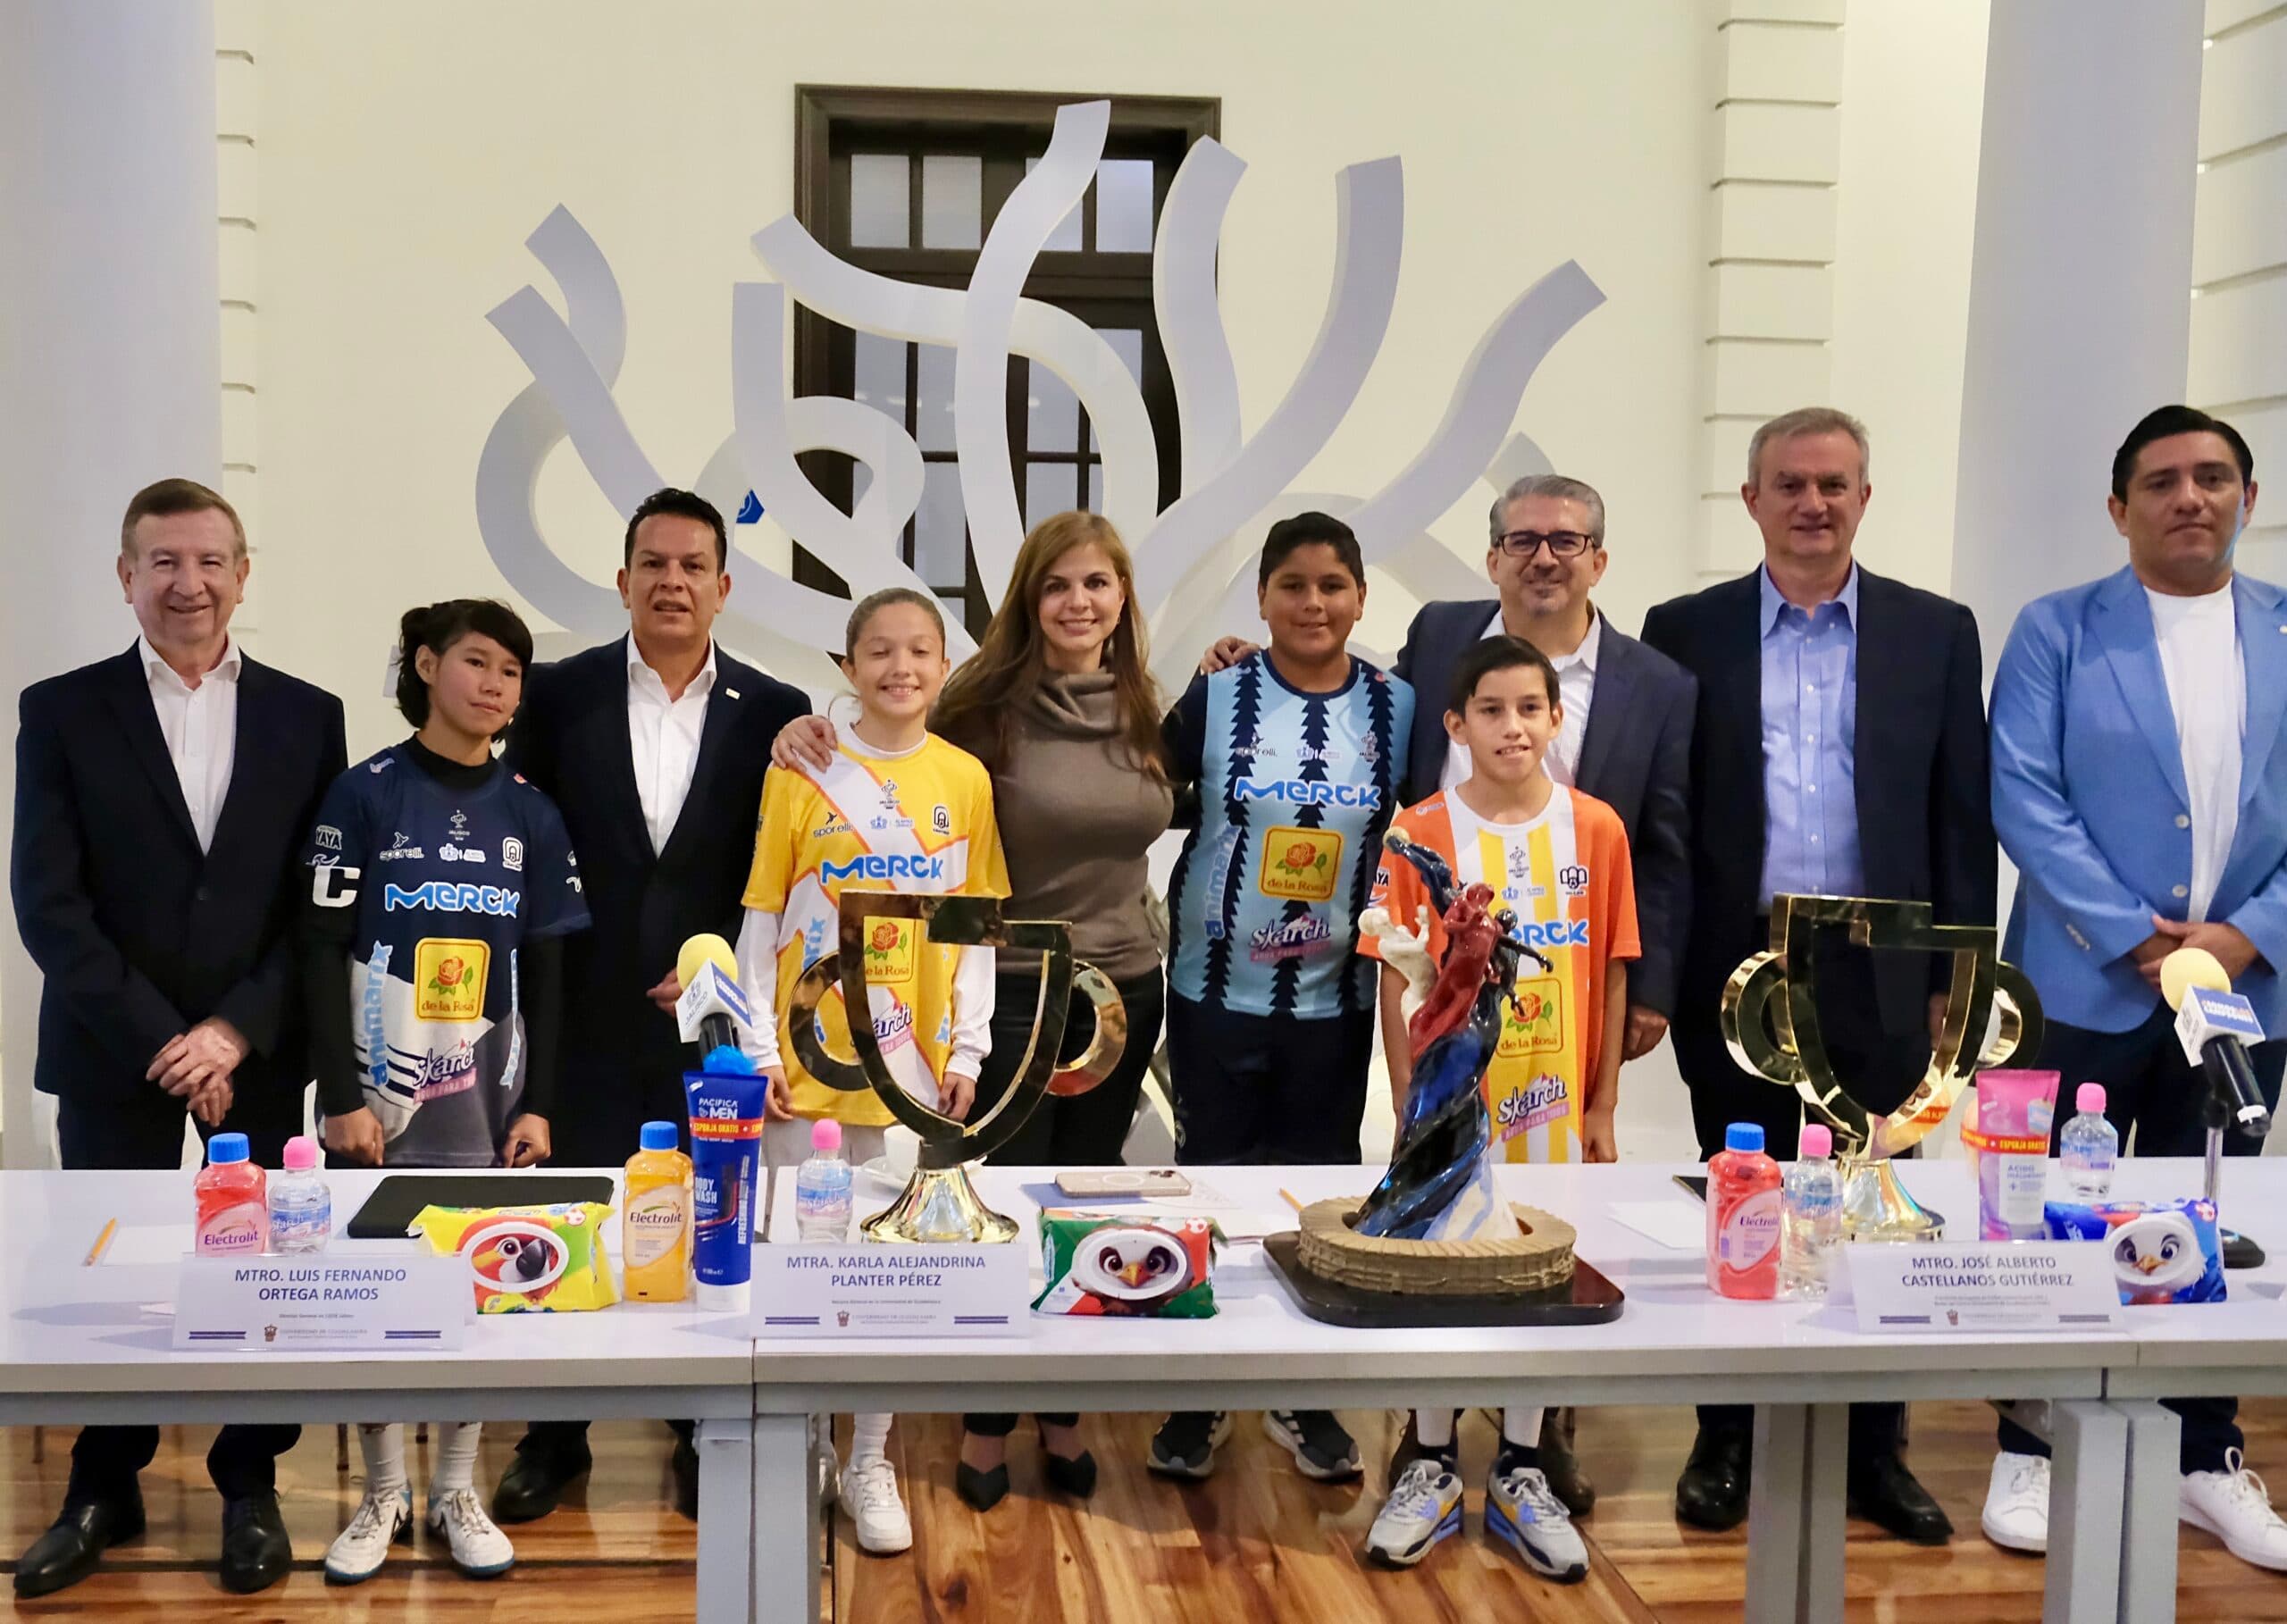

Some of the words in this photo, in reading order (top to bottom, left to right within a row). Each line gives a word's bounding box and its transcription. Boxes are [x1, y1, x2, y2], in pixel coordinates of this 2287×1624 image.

[315, 830, 342, 850] YAYA
[313, 865, 361, 908] C
[1376, 872, 1389, 887] YA
[1512, 918, 1588, 946] RCK
[875, 965, 884, 976] la
[885, 965, 909, 976] Rosa
[421, 1000, 435, 1012] de
[438, 1001, 450, 1012] la
[872, 1002, 913, 1039] arch
[1500, 1036, 1515, 1051] de
[1517, 1036, 1529, 1050] la
[1530, 1034, 1557, 1048] Rosa
[698, 1097, 739, 1108] PACIFICA
[709, 1107, 738, 1120] MEN
[630, 1211, 682, 1224] Electrolit
[204, 1230, 259, 1246] Electrolit
[787, 1256, 834, 1269] MTRA.
[838, 1256, 884, 1268] KARLA
[888, 1256, 986, 1268] ALEJANDRINA
[1912, 1257, 1958, 1269] MTRO.
[1961, 1255, 1992, 1268] JOSÉ
[1997, 1256, 2057, 1268] ALBERTO
[235, 1269, 284, 1282] MTRO.
[289, 1269, 320, 1282] LUIS
[324, 1269, 406, 1282] FERNANDO
[832, 1275, 894, 1287] PLANTER
[899, 1271, 942, 1287] PÉREZ
[1902, 1275, 1996, 1287] CASTELLANOS
[1999, 1272, 2073, 1287] GUTIÉRREZ
[259, 1288, 319, 1301] ORTEGA
[323, 1287, 379, 1301] RAMOS
